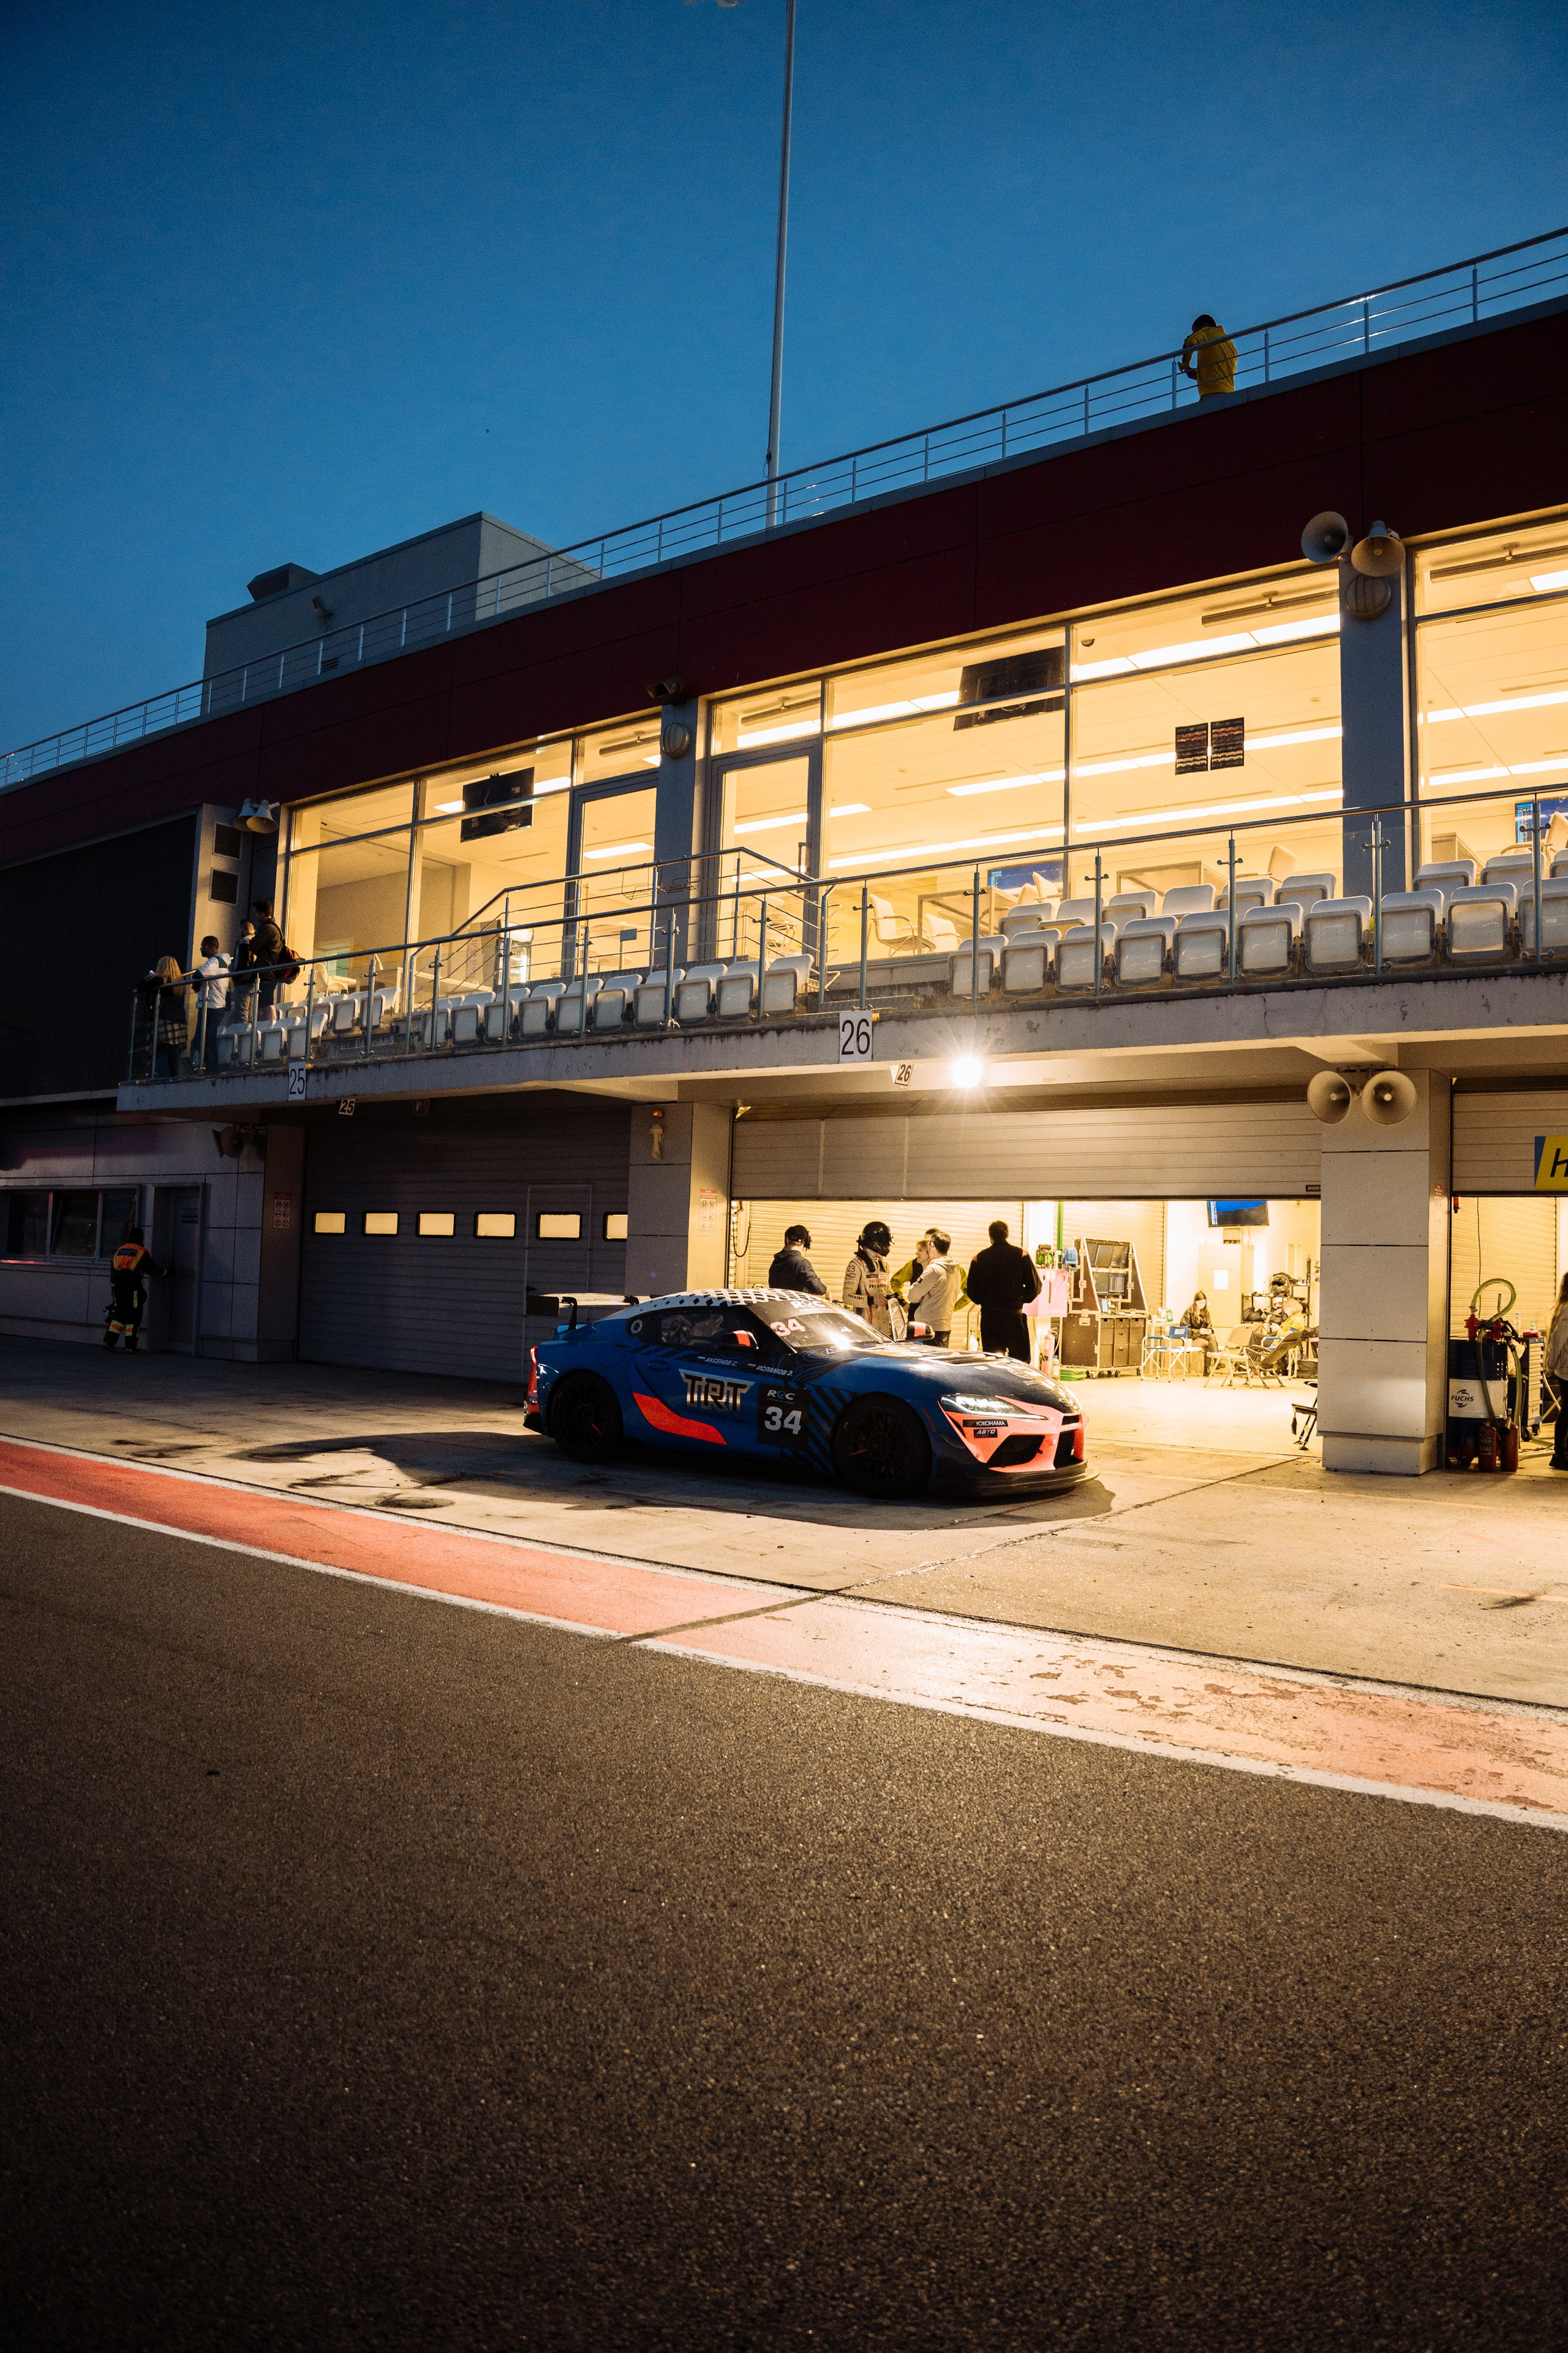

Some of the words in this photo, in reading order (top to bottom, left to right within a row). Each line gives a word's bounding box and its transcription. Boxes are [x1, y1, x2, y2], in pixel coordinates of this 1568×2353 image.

[841, 1018, 870, 1055] 26
[289, 1068, 305, 1095] 25
[897, 1064, 912, 1082] 26
[340, 1099, 355, 1114] 25
[770, 1318, 806, 1337] 34
[704, 1357, 732, 1366] АКСЕНОВ
[679, 1369, 755, 1414] TRT
[764, 1406, 802, 1435] 34
